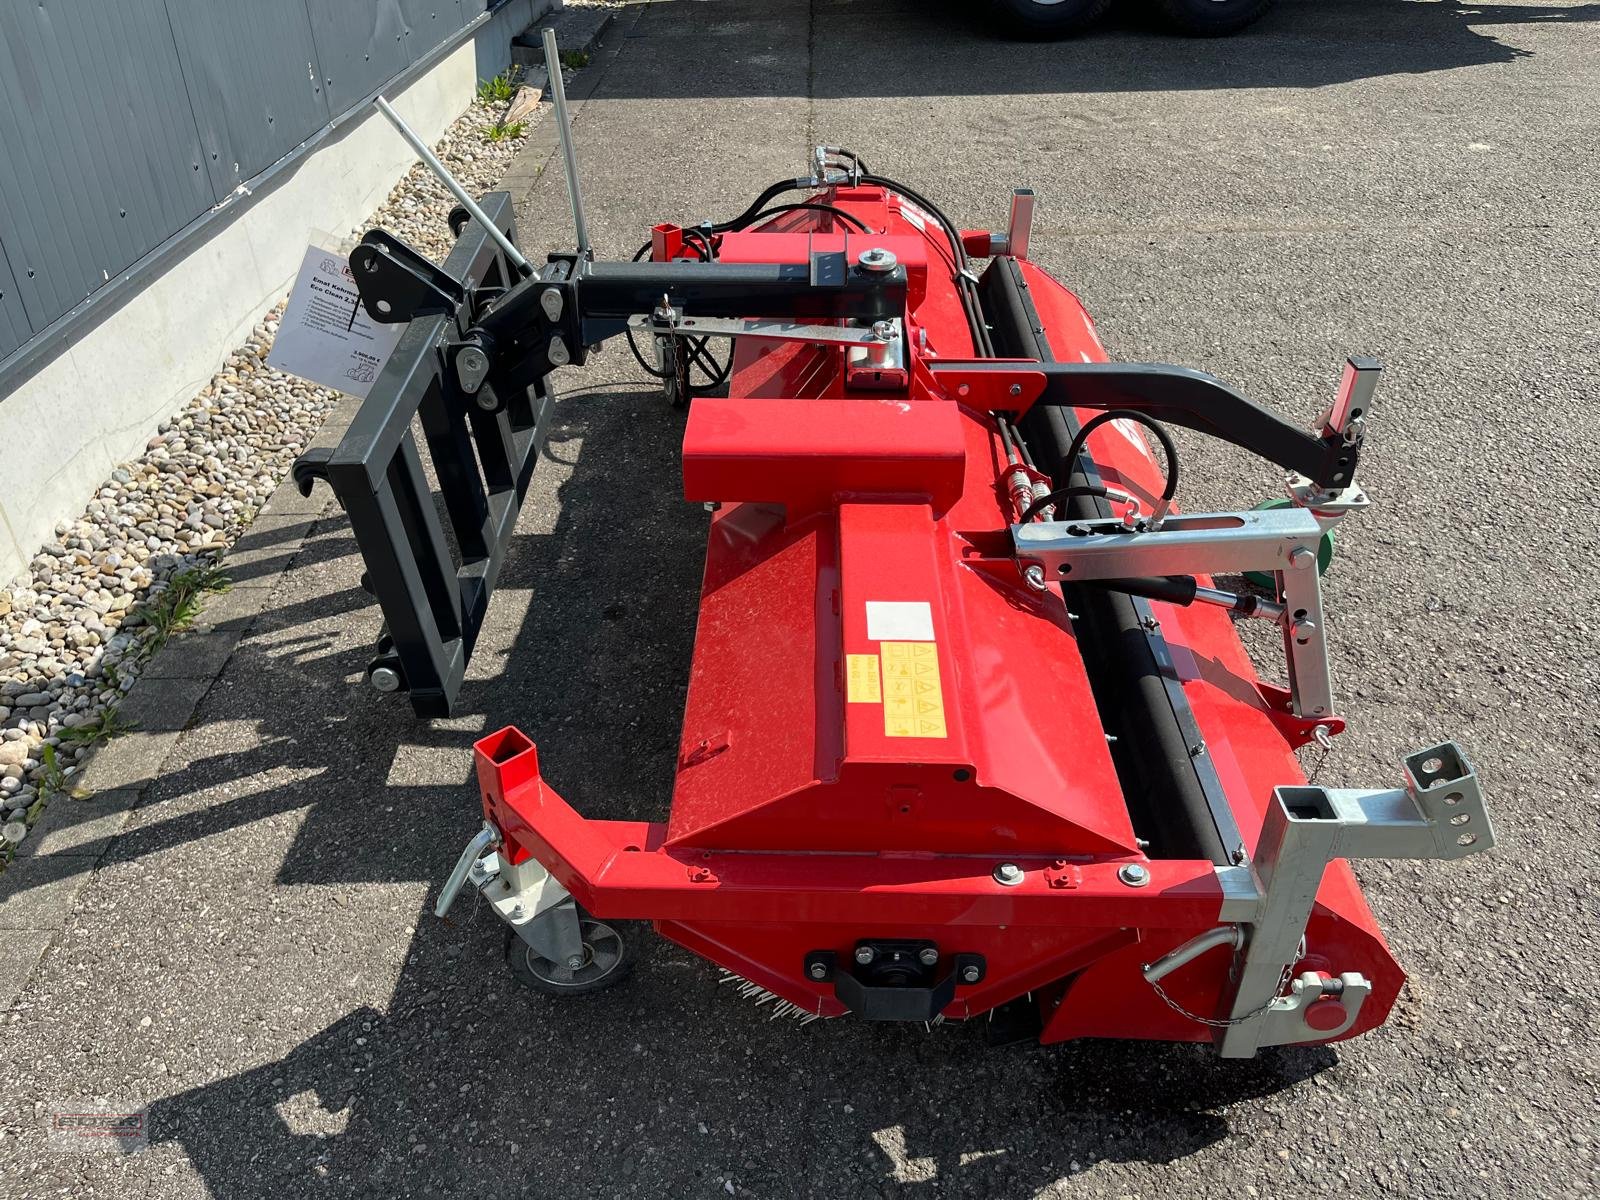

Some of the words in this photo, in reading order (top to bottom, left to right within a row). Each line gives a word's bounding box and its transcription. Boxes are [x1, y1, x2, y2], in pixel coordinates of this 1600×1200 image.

[313, 276, 331, 287] Emat
[310, 283, 323, 292] Eco
[324, 289, 344, 300] Clean
